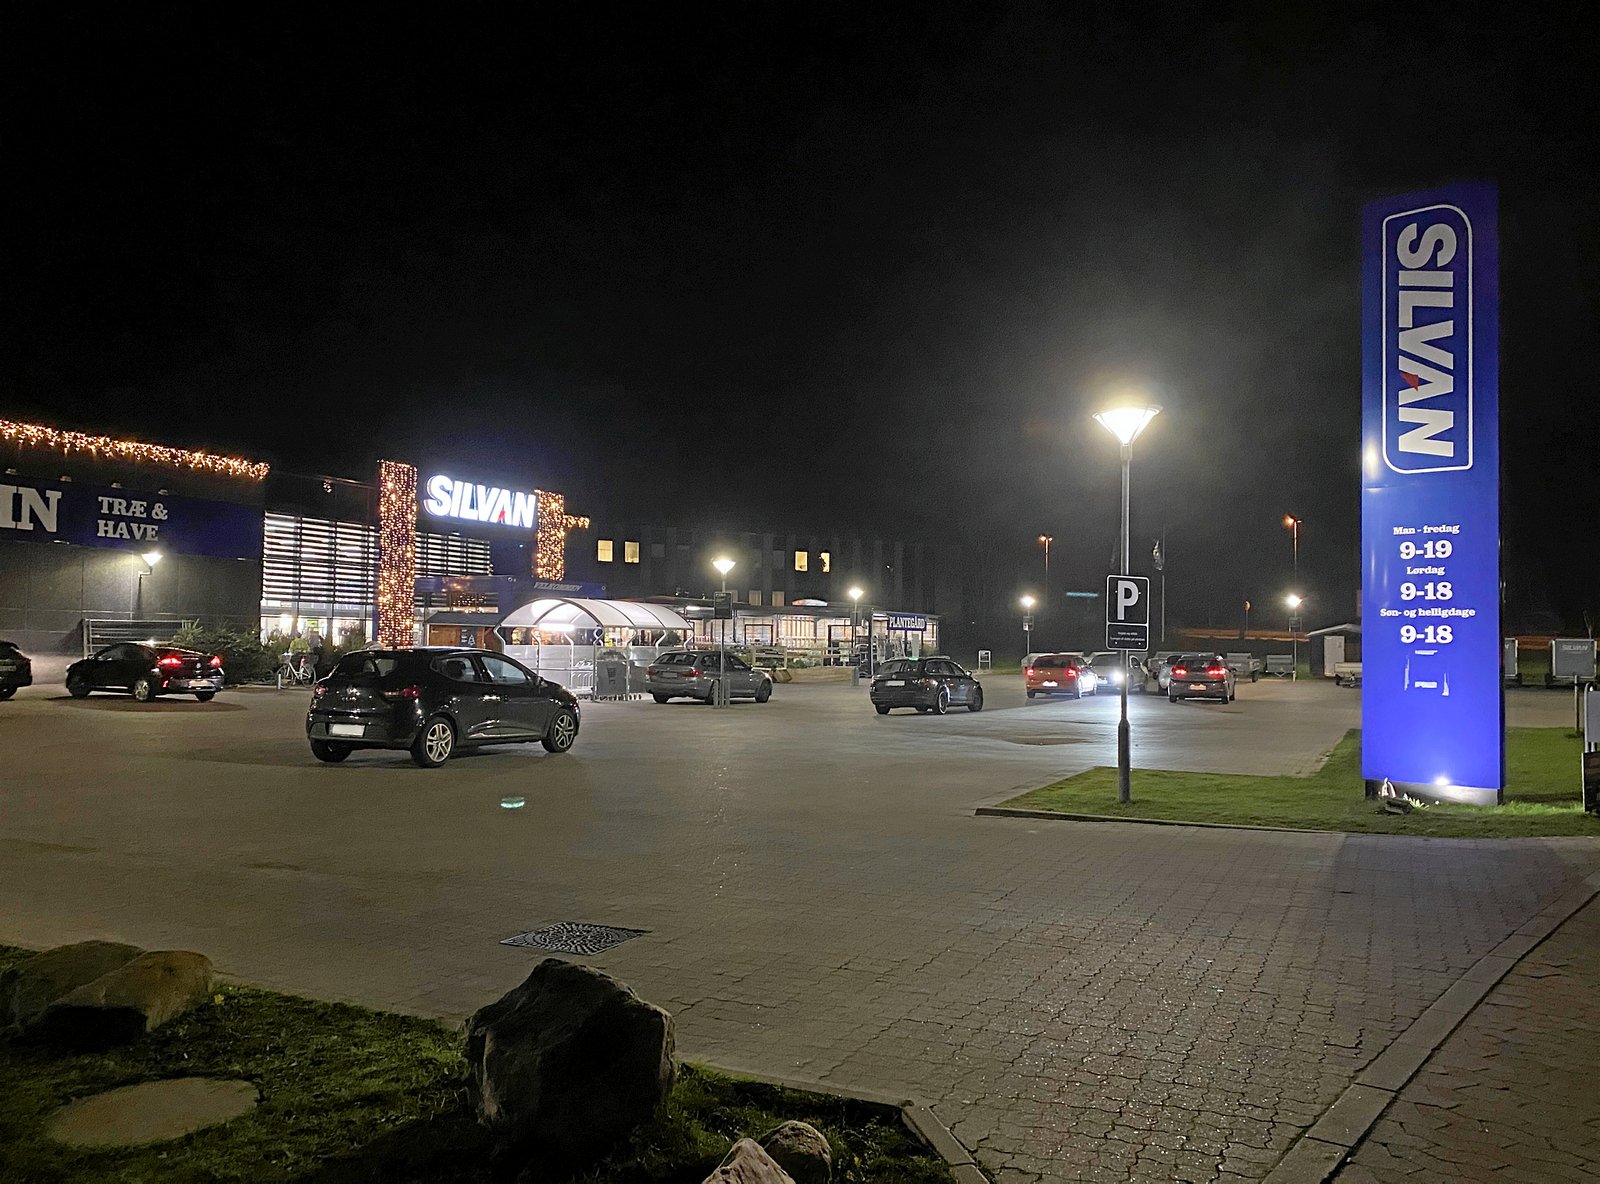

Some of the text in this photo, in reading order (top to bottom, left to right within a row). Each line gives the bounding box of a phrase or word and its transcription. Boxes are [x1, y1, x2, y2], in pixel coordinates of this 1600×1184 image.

[1396, 222, 1457, 457] SILVAN
[97, 496, 169, 520] TRÆ &
[423, 474, 537, 529] SILVAN
[96, 519, 159, 541] HAVE
[1393, 526, 1416, 535] Man
[1423, 524, 1460, 535] fredag
[1399, 540, 1453, 560] 9-19
[1406, 566, 1446, 576] Lørdag
[1117, 580, 1139, 620] P
[1400, 581, 1453, 601] 9-18
[1380, 607, 1476, 618] Søn- og helligdage
[1400, 625, 1454, 644] 9-18
